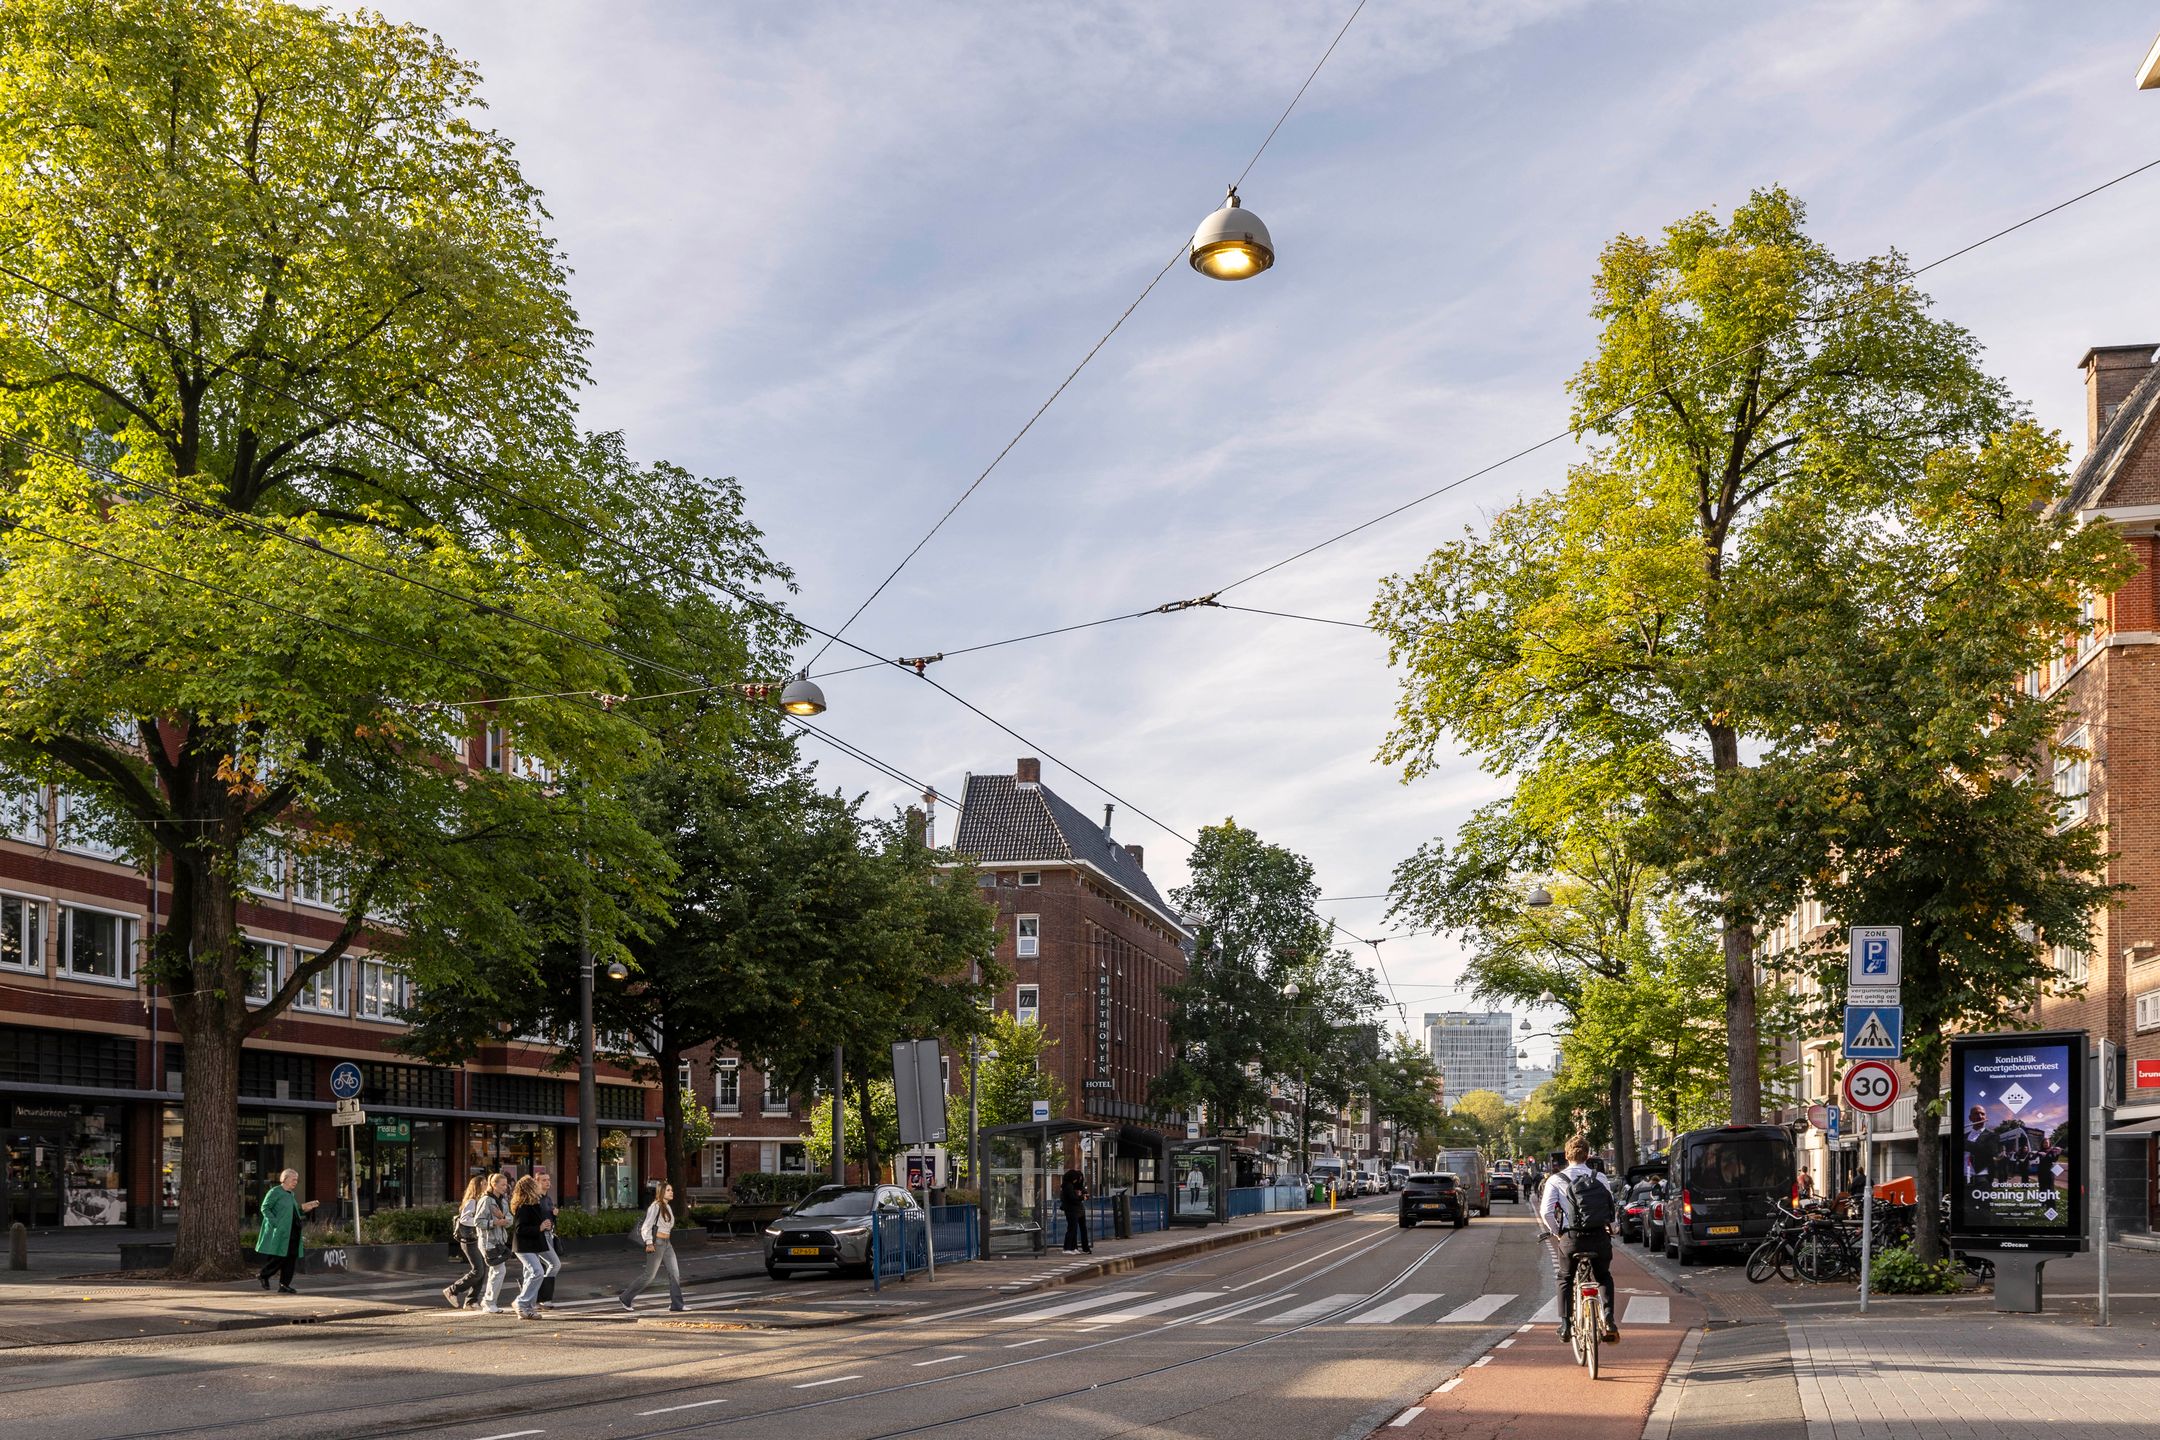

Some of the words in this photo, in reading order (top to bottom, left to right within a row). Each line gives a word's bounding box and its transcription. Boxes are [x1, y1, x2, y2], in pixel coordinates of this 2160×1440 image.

[1868, 942, 1883, 960] P
[1995, 1055, 2037, 1064] Koninklijk
[1973, 1063, 2059, 1073] Concertgebouworkest
[2138, 1070, 2160, 1078] brun
[1854, 1076, 1890, 1097] 30
[1829, 1109, 1837, 1126] P
[1971, 1189, 2025, 1202] Opening
[2026, 1189, 2061, 1202] Night
